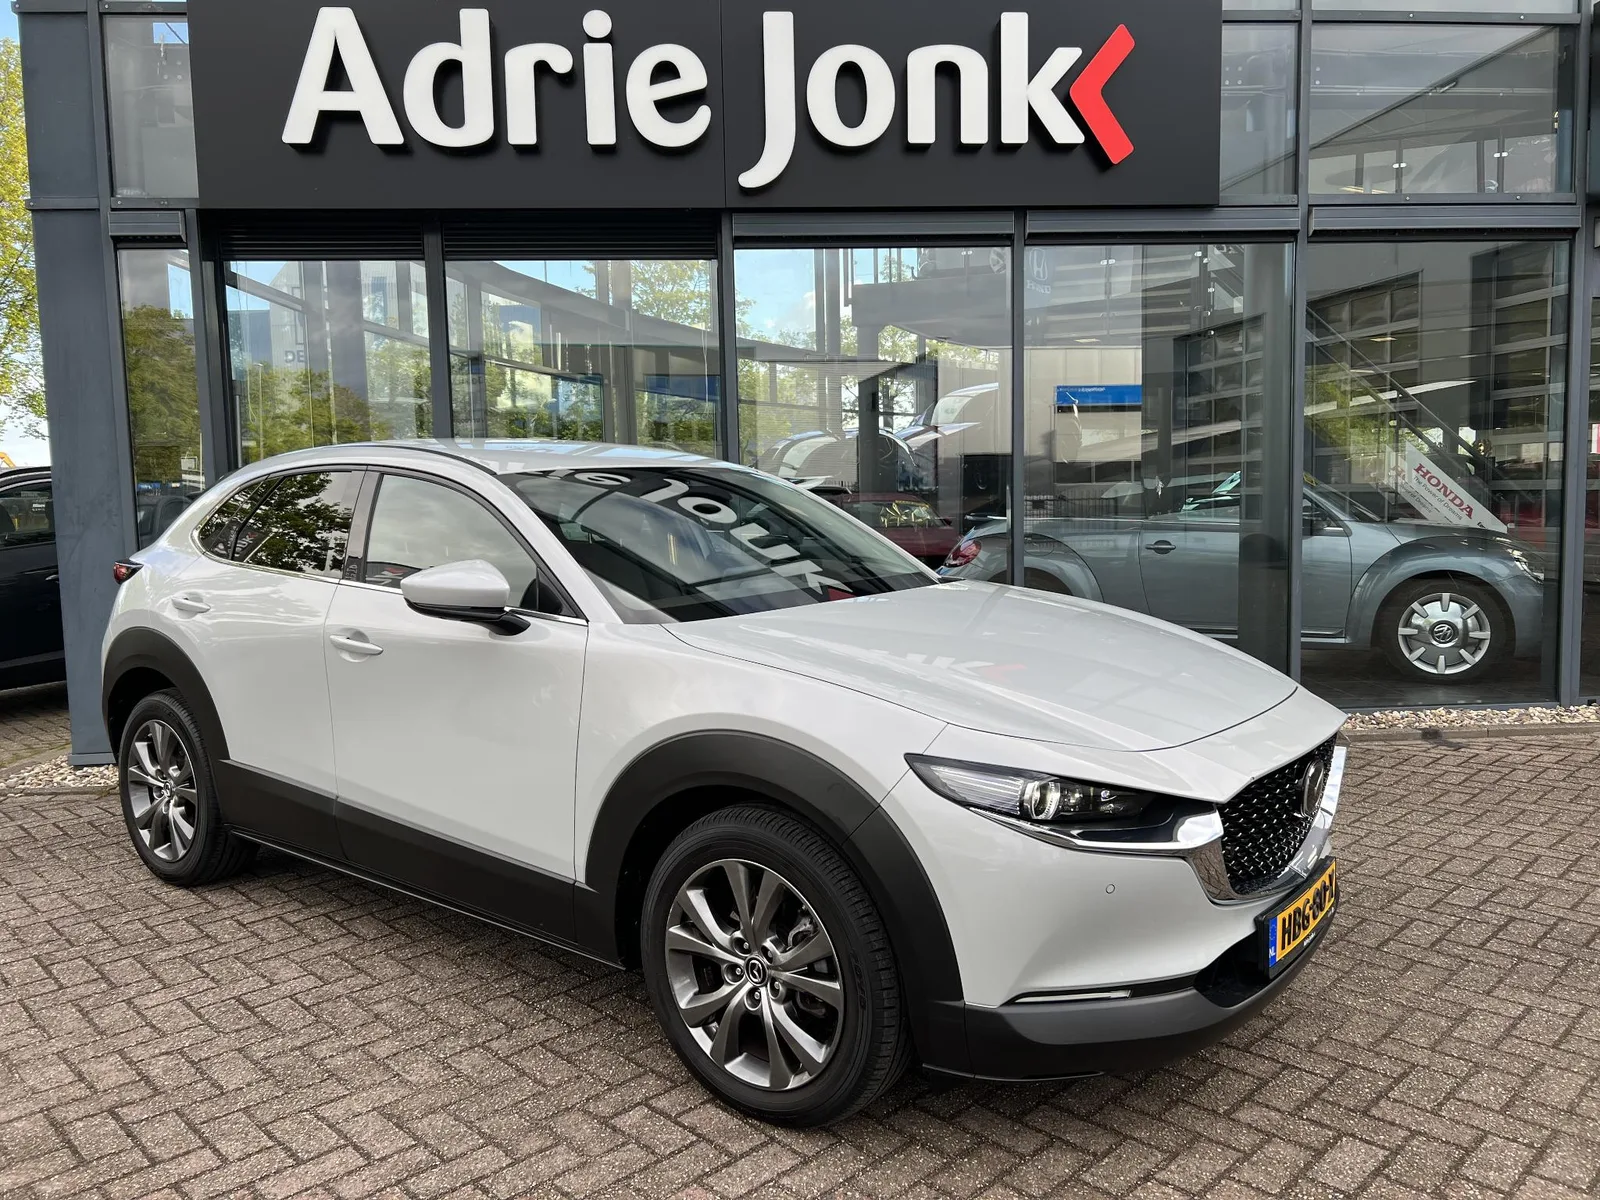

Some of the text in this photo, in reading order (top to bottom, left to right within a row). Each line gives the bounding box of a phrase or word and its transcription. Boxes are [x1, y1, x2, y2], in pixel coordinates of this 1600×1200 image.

[281, 6, 1085, 190] Adrie Jonk
[1413, 475, 1423, 485] The
[1422, 483, 1438, 499] Power
[1442, 502, 1463, 520] Dreams
[1414, 463, 1474, 519] HONDA
[1268, 946, 1276, 958] NL
